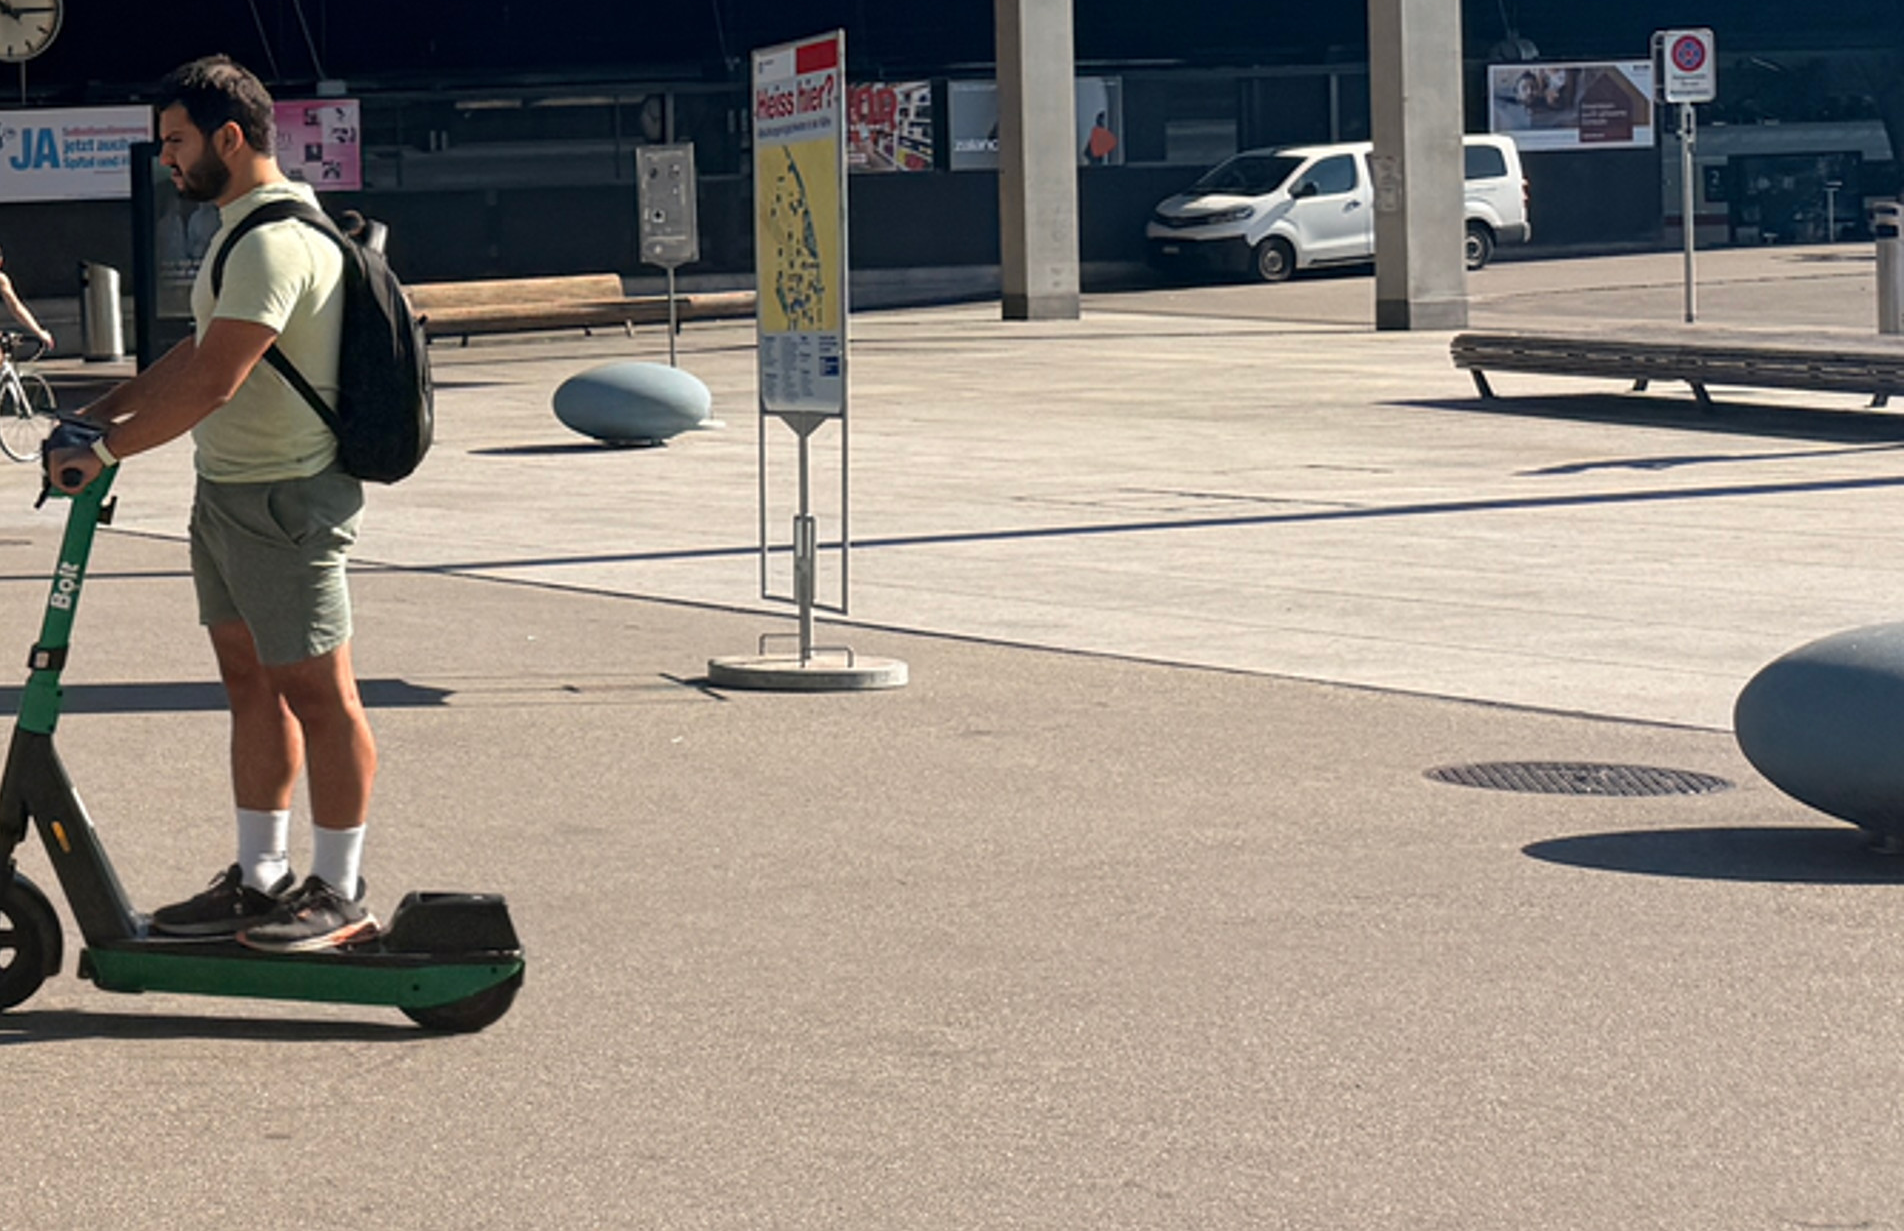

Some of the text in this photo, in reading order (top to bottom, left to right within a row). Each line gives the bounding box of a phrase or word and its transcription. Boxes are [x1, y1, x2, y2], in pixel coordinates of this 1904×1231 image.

[756, 84, 794, 121] Heiss
[796, 72, 834, 115] hier?
[10, 127, 60, 171] JA
[51, 561, 81, 609] Bolt
